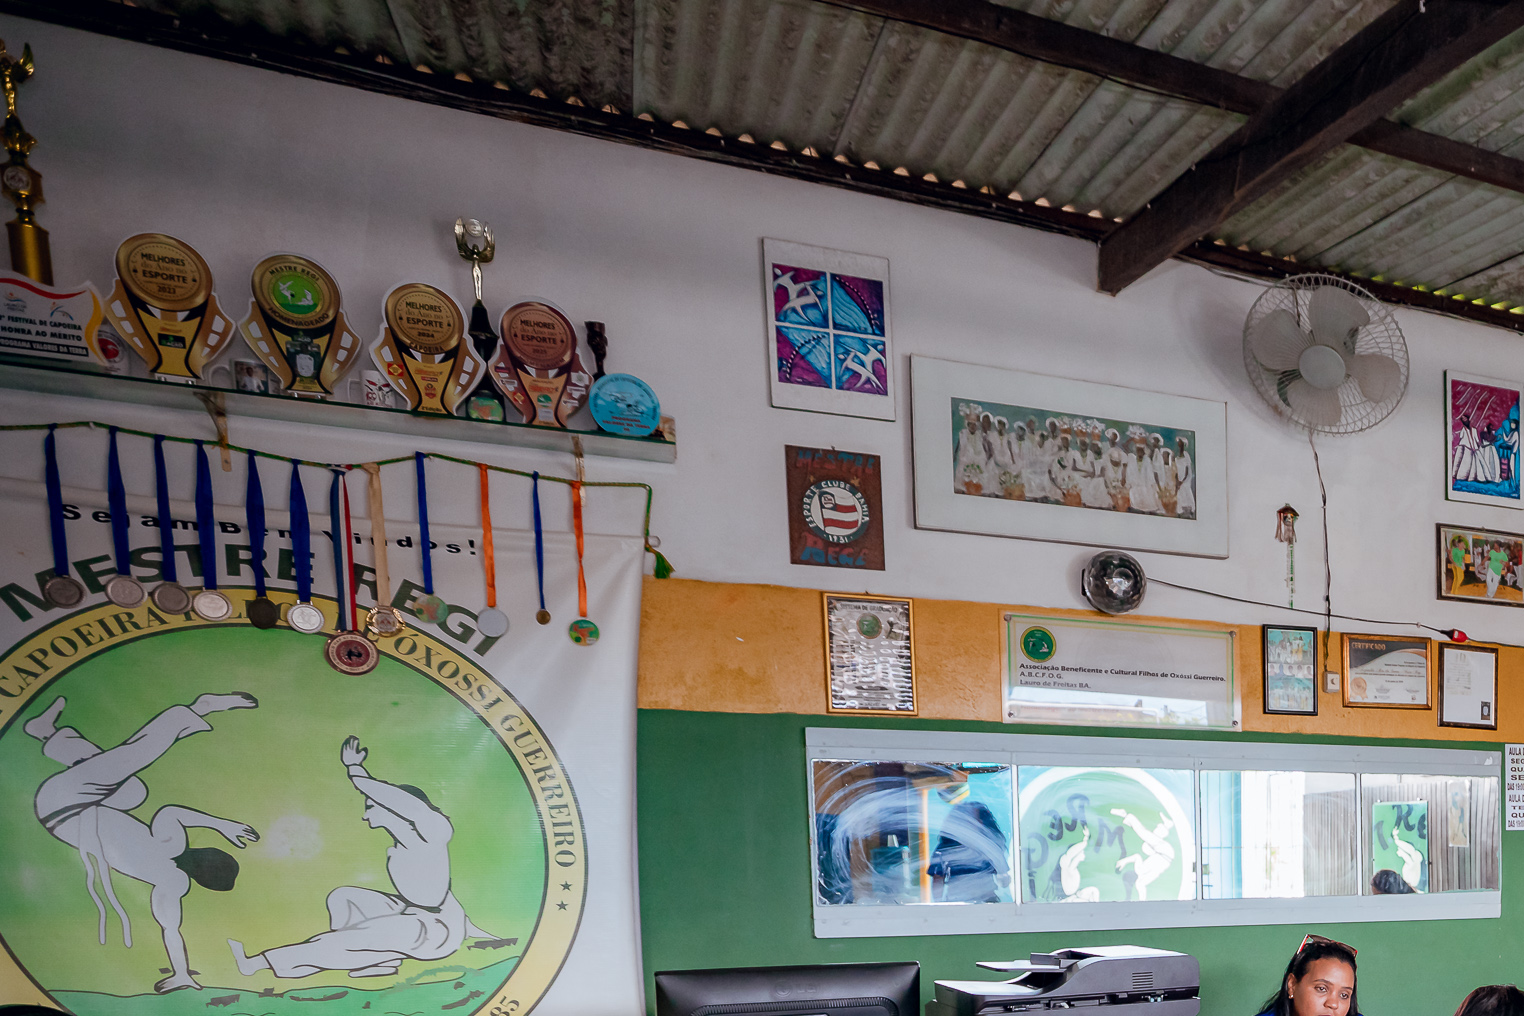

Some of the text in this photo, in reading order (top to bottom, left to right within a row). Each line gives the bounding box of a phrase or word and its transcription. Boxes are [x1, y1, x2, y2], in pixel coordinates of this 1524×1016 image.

[141, 252, 185, 267] MELHORES
[142, 269, 188, 284] ESPORTE
[268, 264, 298, 276] MESTRE
[405, 301, 442, 313] MELHORES
[7, 315, 37, 326] FESTIVAL
[49, 320, 82, 331] CAPOEIRA
[268, 306, 330, 327] HOMENAGEADO
[406, 316, 444, 329] ESPORTE
[0, 325, 32, 335] HONRA
[35, 329, 47, 337] AO
[520, 319, 556, 330] MELHORES
[521, 333, 557, 346] ESPORTE
[409, 341, 445, 354] CAPOEIRA
[803, 485, 820, 528] ESPORTE
[821, 480, 851, 491] CLUBE
[1020, 663, 1060, 673] Associação
[1061, 666, 1102, 674] Beneficente
[1110, 668, 1137, 676] Cultural
[1194, 674, 1226, 682] Guerreiro.
[0, 601, 169, 698] CAPOEIRA
[393, 632, 504, 713] ÓXOSSI
[500, 713, 577, 869] GUERREIRO
[1509, 747, 1521, 756] AULA
[1509, 794, 1521, 803] AULA
